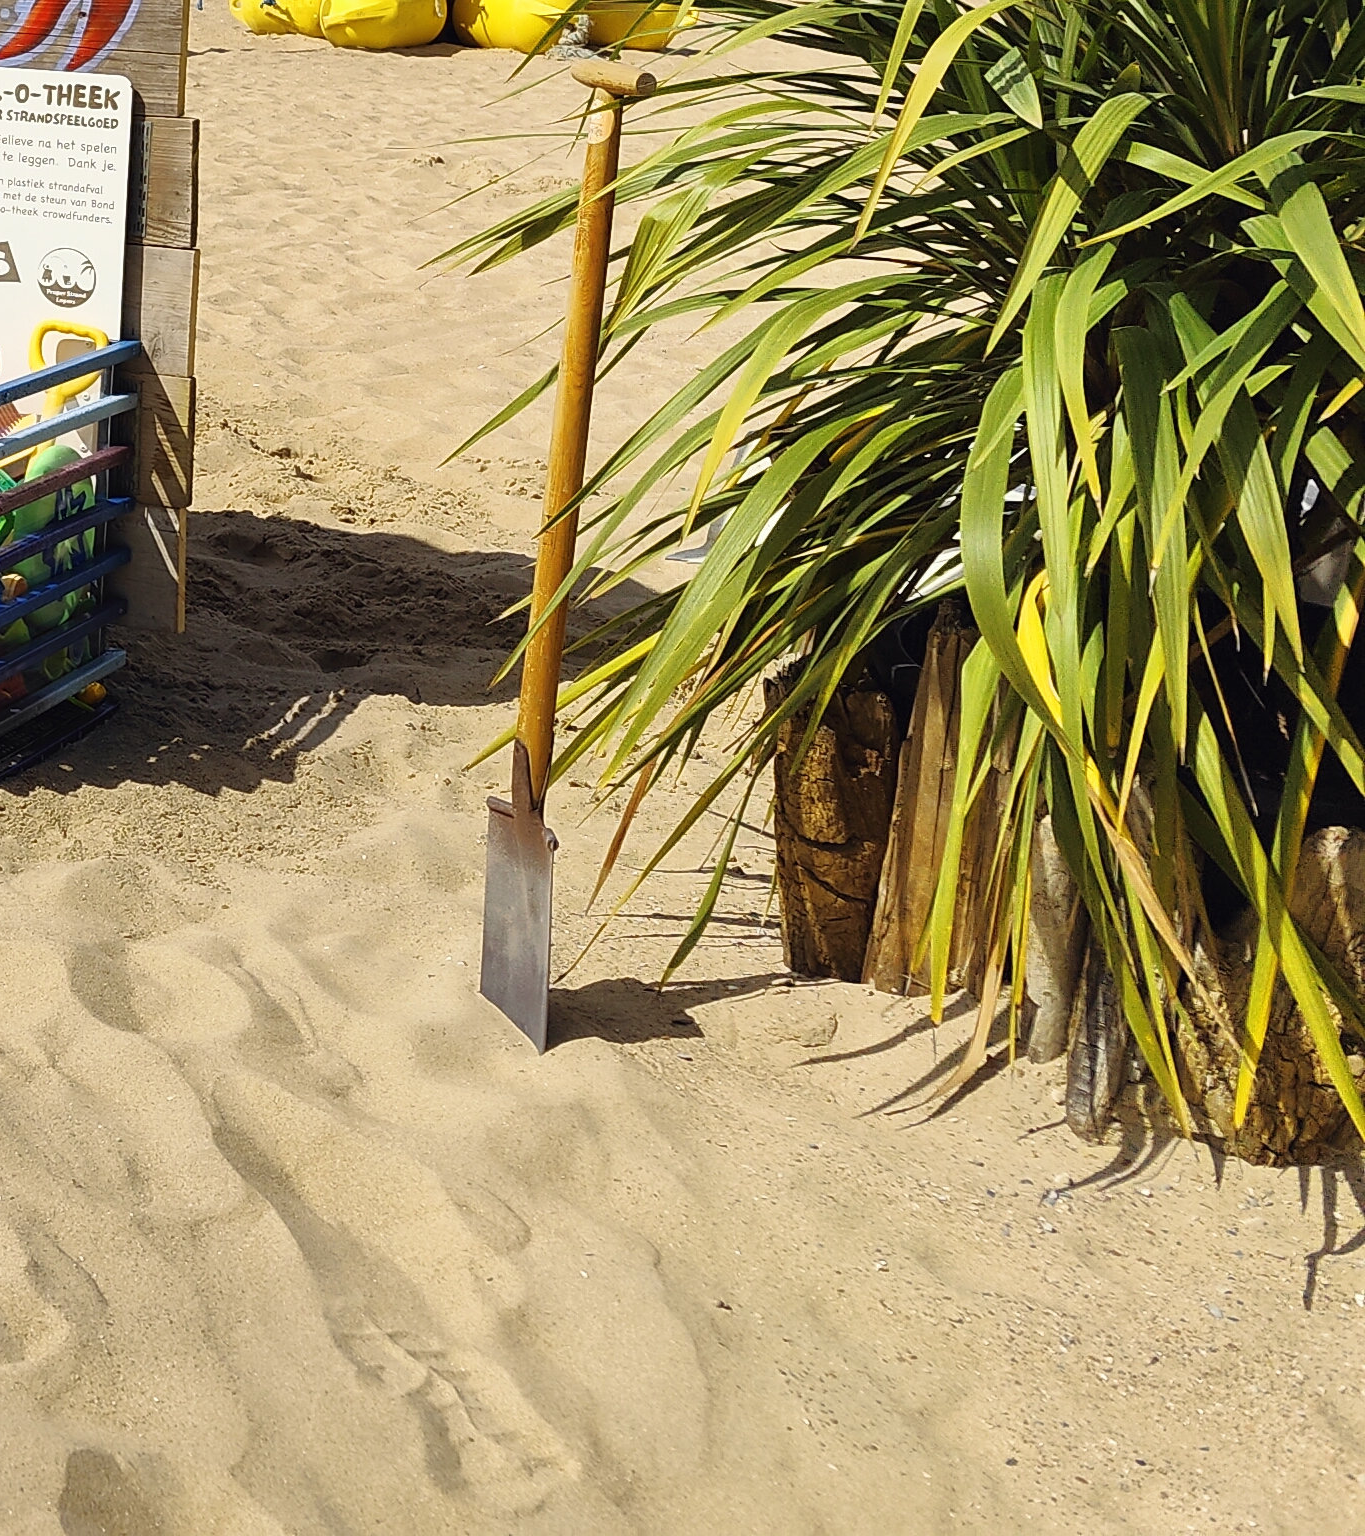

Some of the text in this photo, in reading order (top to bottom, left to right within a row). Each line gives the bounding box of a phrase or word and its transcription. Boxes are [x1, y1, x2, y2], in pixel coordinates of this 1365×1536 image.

[6, 109, 119, 129] STRANDSPEELGOED
[38, 140, 51, 148] na
[57, 139, 76, 150] het
[80, 143, 117, 155] spelen
[2, 151, 13, 162] te
[18, 153, 58, 167] leggen.
[68, 158, 96, 169] Dank
[102, 160, 116, 172] je.
[7, 177, 45, 189] plastiek
[48, 181, 103, 195] strandafval
[3, 192, 21, 201] met
[25, 193, 36, 202] de
[40, 195, 66, 205] steun
[70, 198, 87, 207] van
[91, 200, 115, 210] Bond
